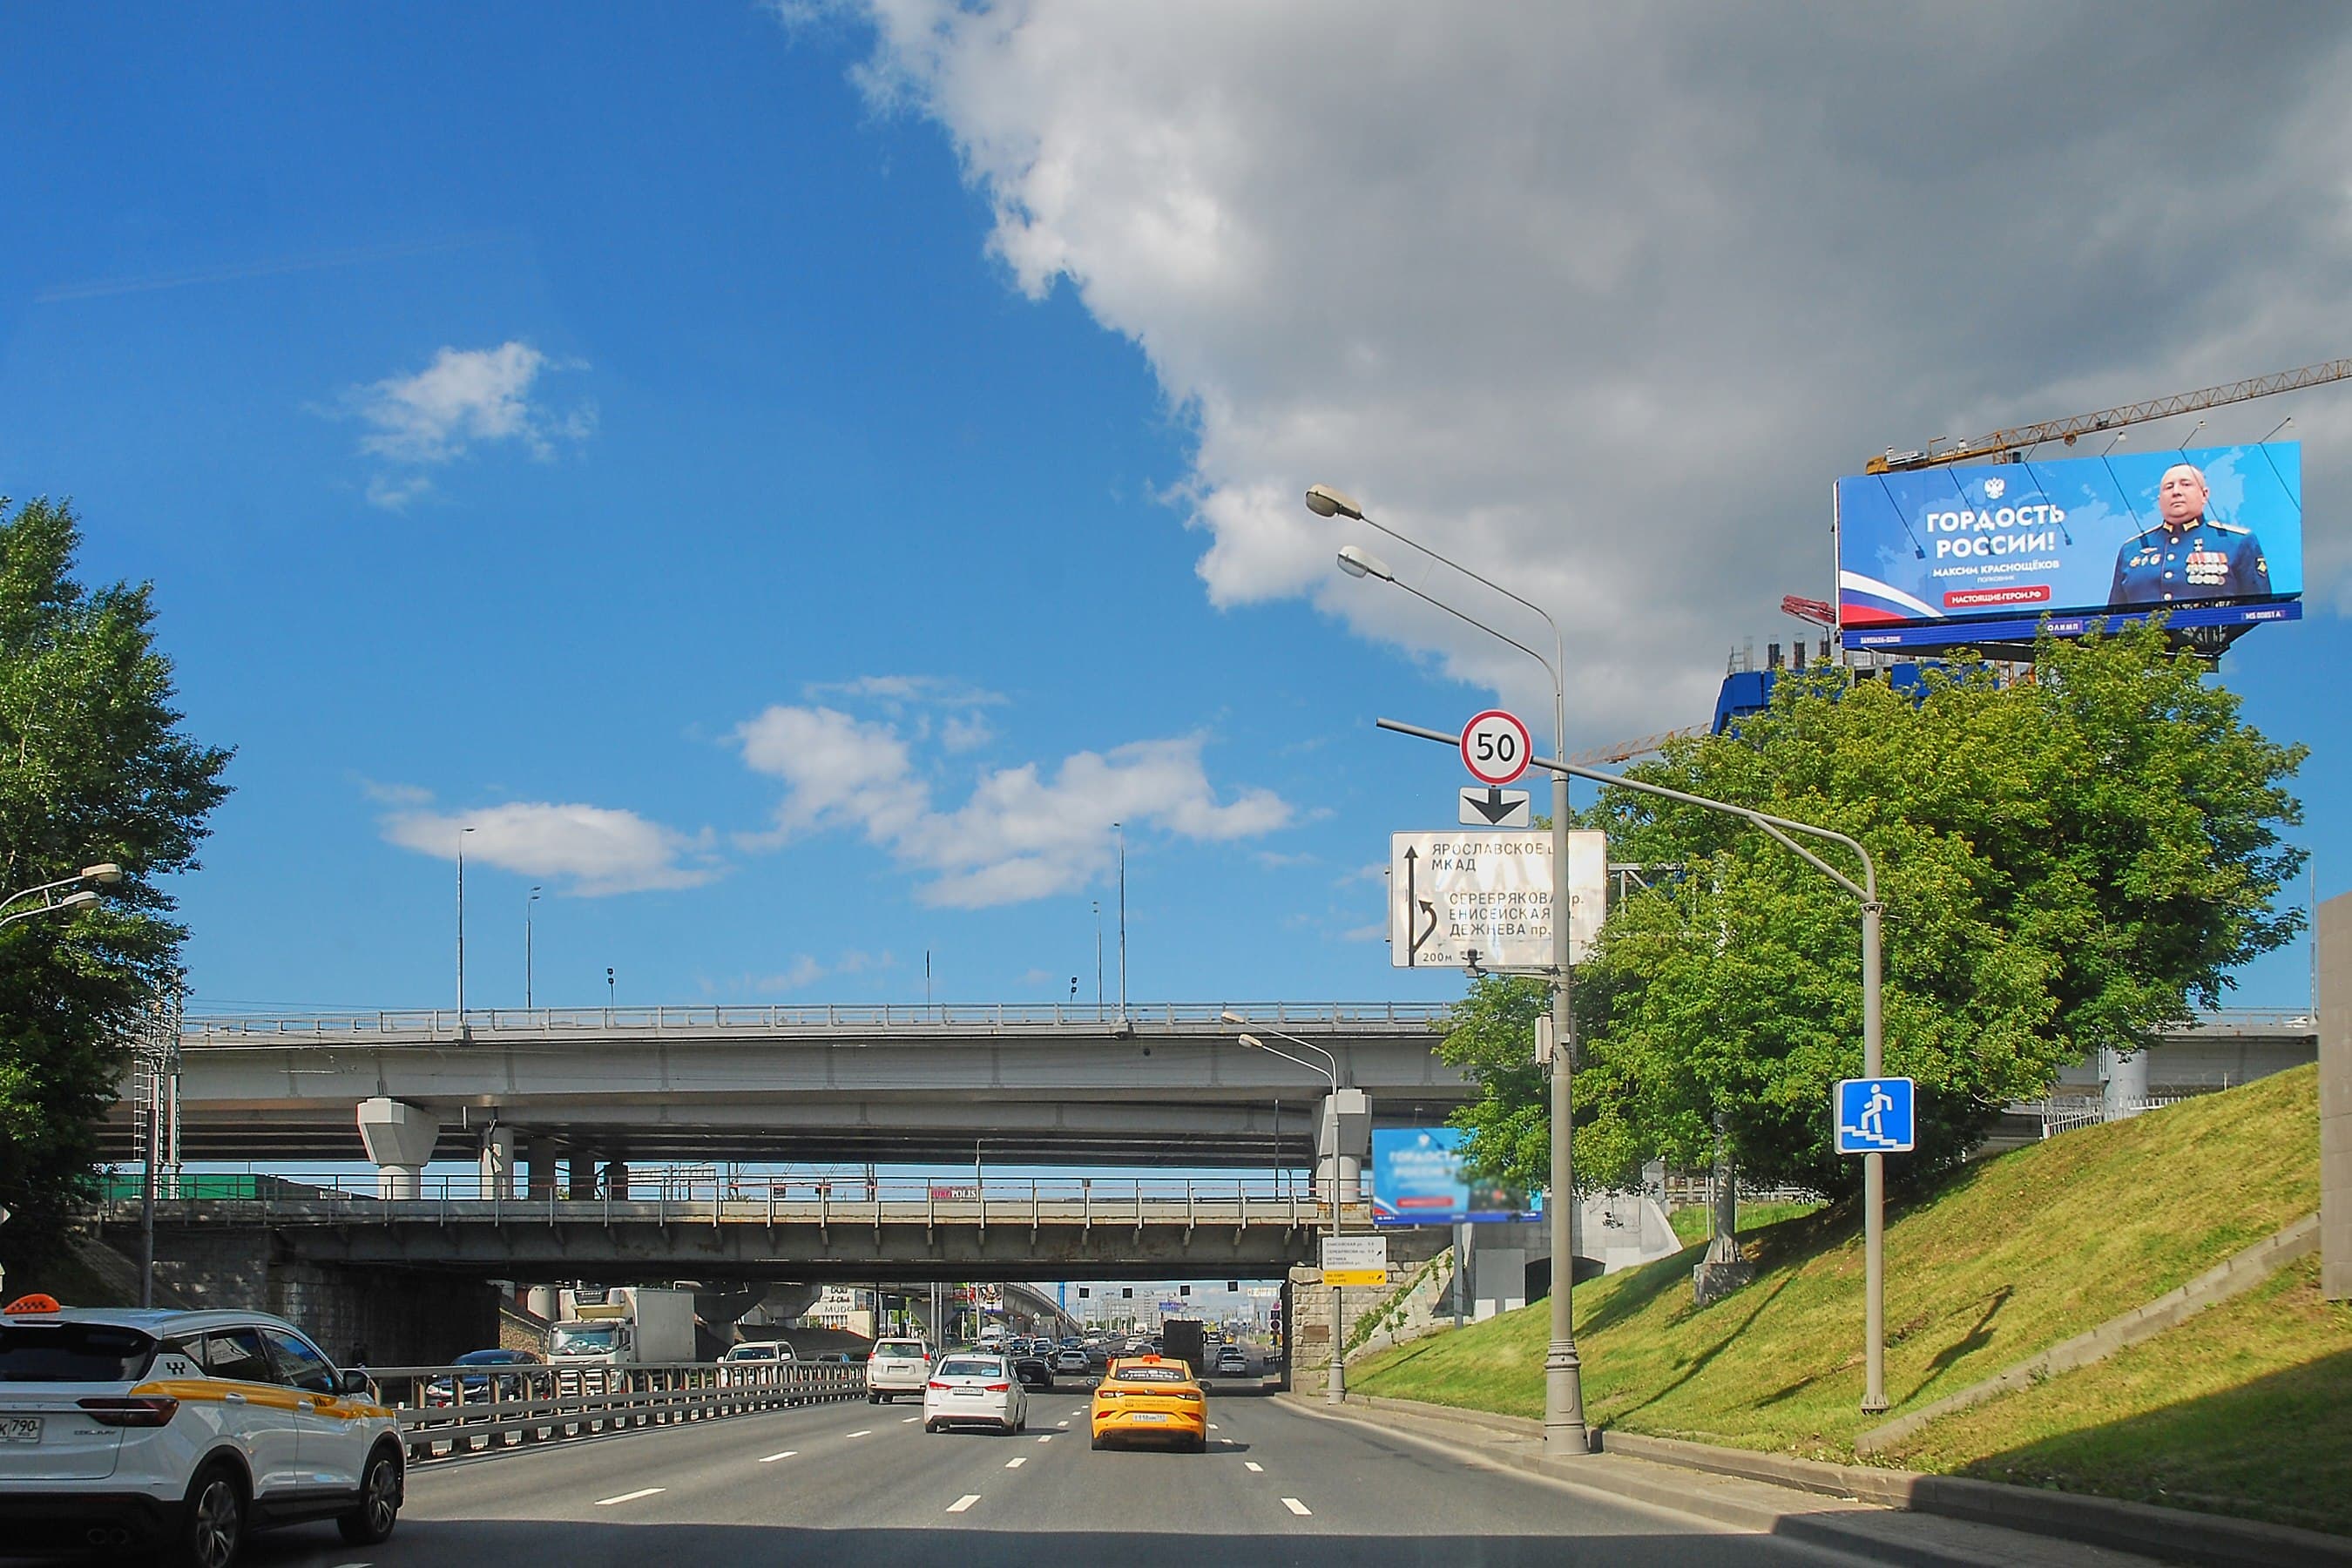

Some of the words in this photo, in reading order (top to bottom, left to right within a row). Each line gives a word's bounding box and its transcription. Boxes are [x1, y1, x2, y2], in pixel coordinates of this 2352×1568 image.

[1926, 504, 2065, 533] ГОРДОСТЬ
[1936, 531, 2056, 558] РОССИИ!
[1932, 566, 1978, 578] МАКСИМ
[1981, 559, 2060, 574] КРАСНОЩЁКОВ
[1477, 733, 1515, 762] 50
[1432, 843, 1544, 855] ЯРОСЛАВСКОЕ
[1431, 858, 1477, 872] МКАД
[1569, 895, 1584, 906] р.
[1450, 906, 1551, 920] ЕНИСЕЙСКАЯ
[1450, 923, 1525, 936] ДЕЖНЕВА
[1531, 926, 1551, 937] пр.
[12, 1419, 36, 1432] 790
